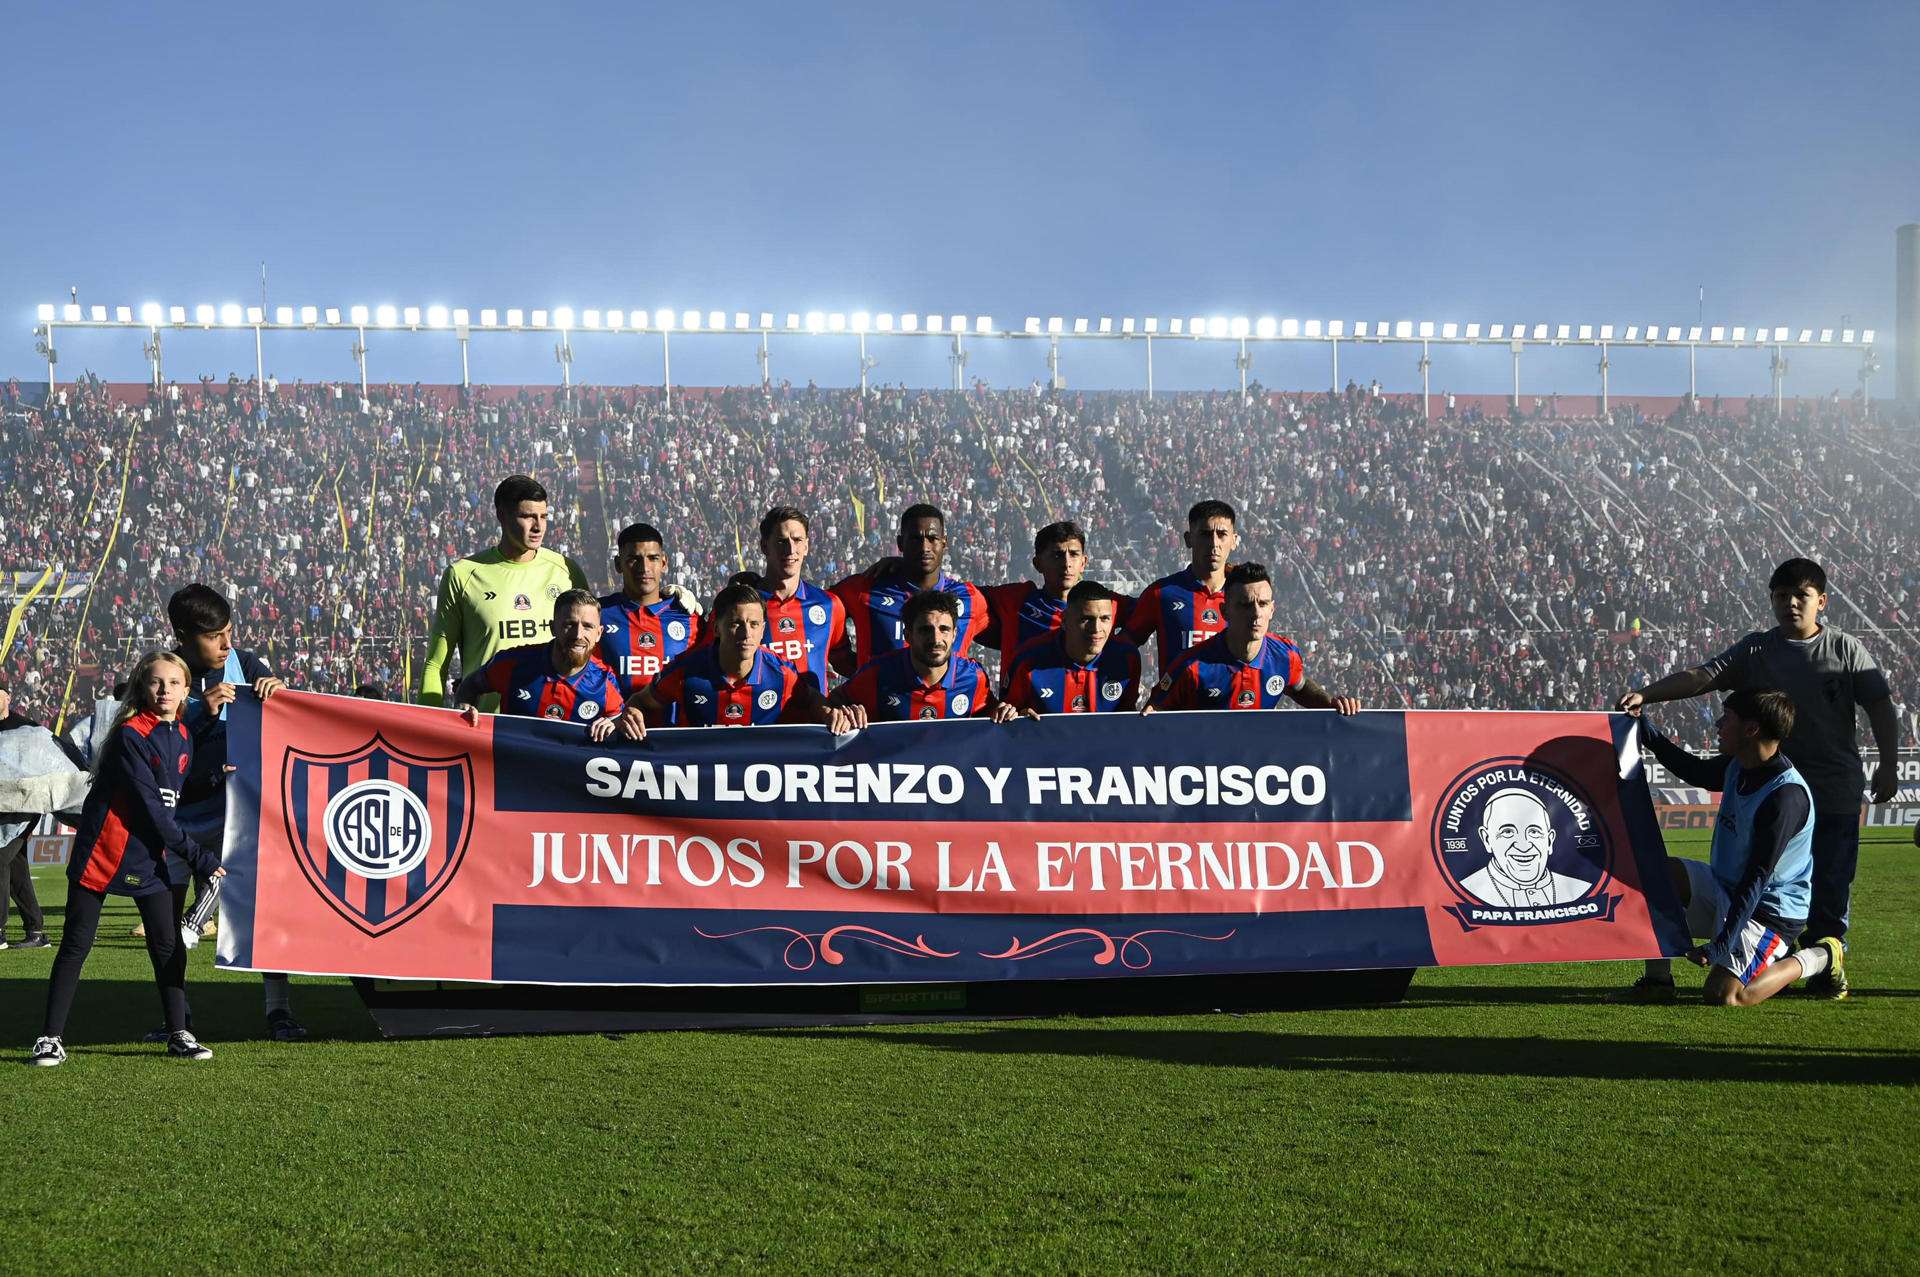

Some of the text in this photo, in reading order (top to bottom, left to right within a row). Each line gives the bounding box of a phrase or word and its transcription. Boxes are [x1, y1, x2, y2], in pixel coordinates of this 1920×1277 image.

[585, 757, 1327, 806] SAN LORENZO Y FRANCISCO
[1446, 769, 1591, 833] JUNTOS POR LA ETERNIDAD
[527, 832, 1385, 892] JUNTOS POR LA ETERNIDAD
[1472, 903, 1599, 921] PAPA FRANCISCO
